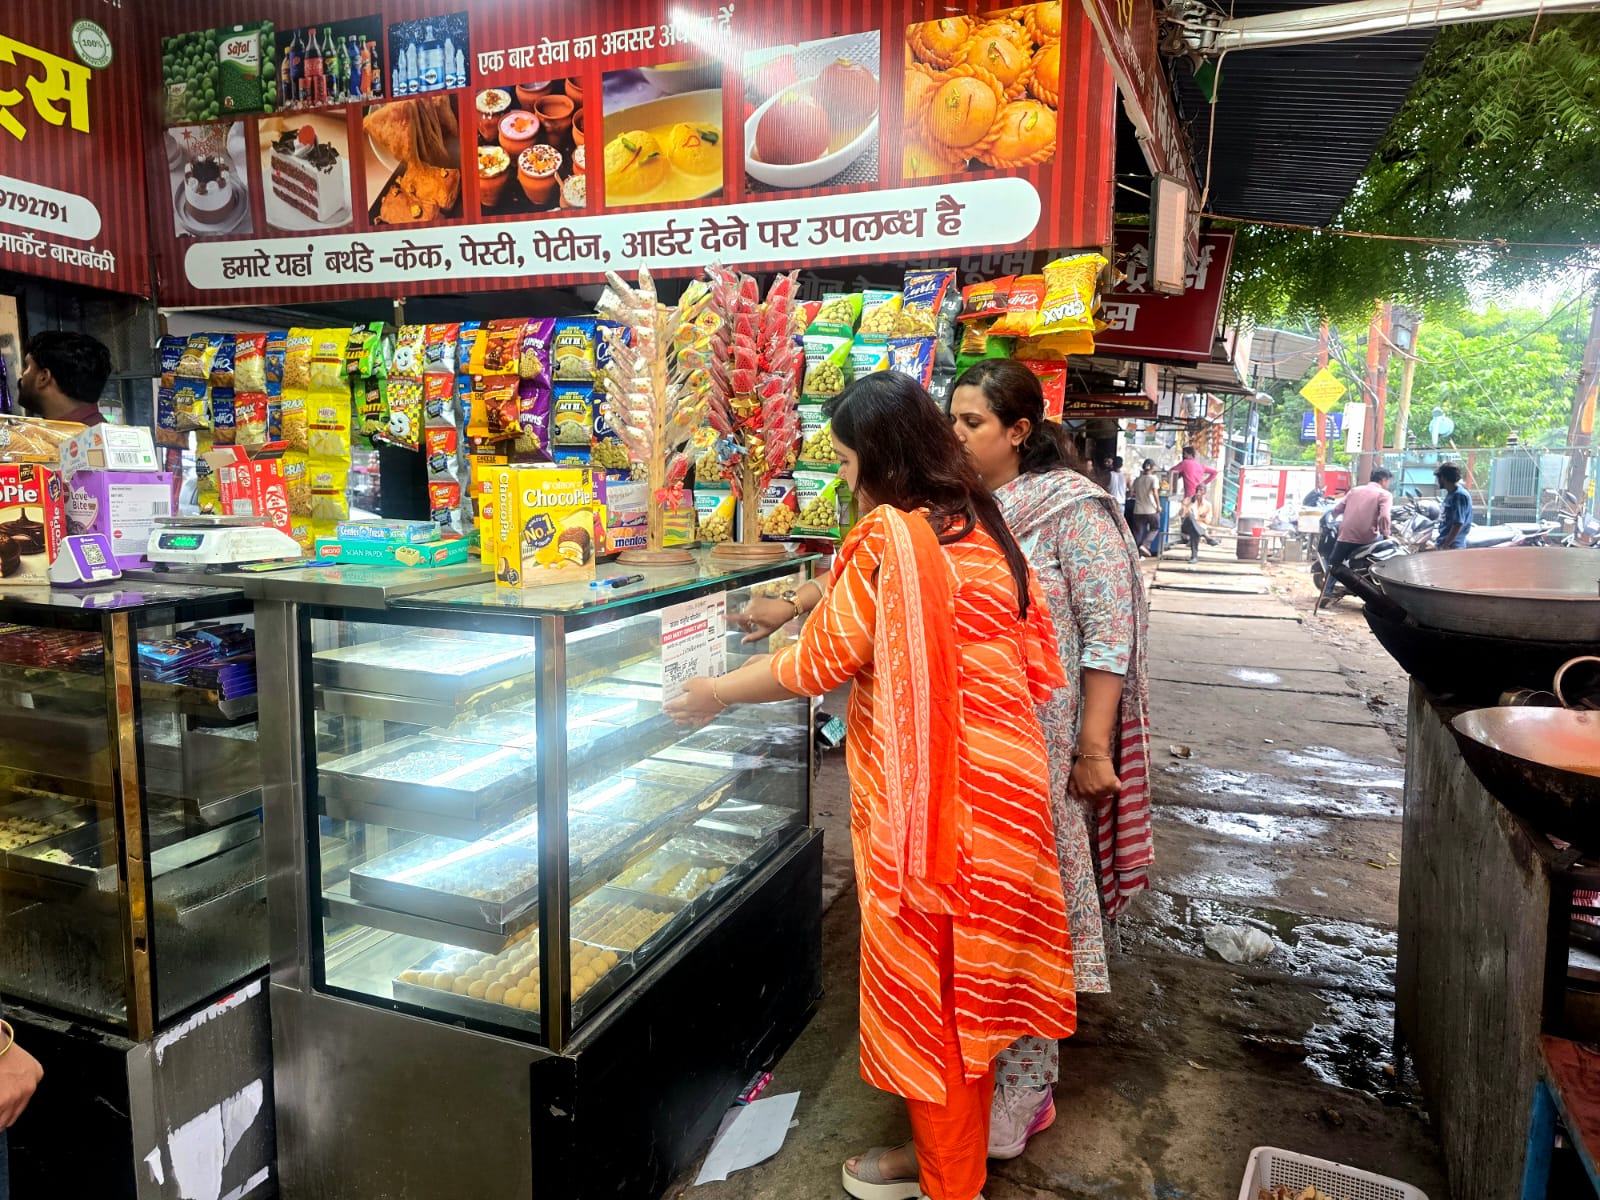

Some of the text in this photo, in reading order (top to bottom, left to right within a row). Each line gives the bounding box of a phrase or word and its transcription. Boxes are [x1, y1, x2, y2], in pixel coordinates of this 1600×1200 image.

[82, 38, 103, 49] 100%
[477, 50, 504, 76] एक
[508, 46, 535, 70] बार
[537, 37, 569, 66] सेवा
[573, 35, 597, 60] का
[601, 25, 656, 56] अवसर
[221, 248, 270, 280] हमारे
[274, 243, 315, 276] यहां
[324, 241, 375, 274] बर्थडे
[532, 226, 612, 264] पेटीज,
[621, 218, 695, 258] आर्डर
[699, 215, 749, 253] देने
[756, 218, 802, 248] पर
[806, 207, 928, 247] उपलब्ध
[935, 193, 966, 237] है
[49, 243, 116, 274] बाराबंकी
[904, 280, 936, 299] Curls
[1043, 299, 1086, 327] CRAX
[235, 340, 255, 353] CRAX
[287, 337, 311, 348] CRAX
[0, 484, 39, 503] Pie
[71, 484, 89, 501] Love
[522, 488, 591, 508] ChocoPie
[72, 501, 88, 510] Bite
[266, 484, 289, 527] KitKat
[340, 525, 360, 537] Center
[615, 535, 648, 548] mentos
